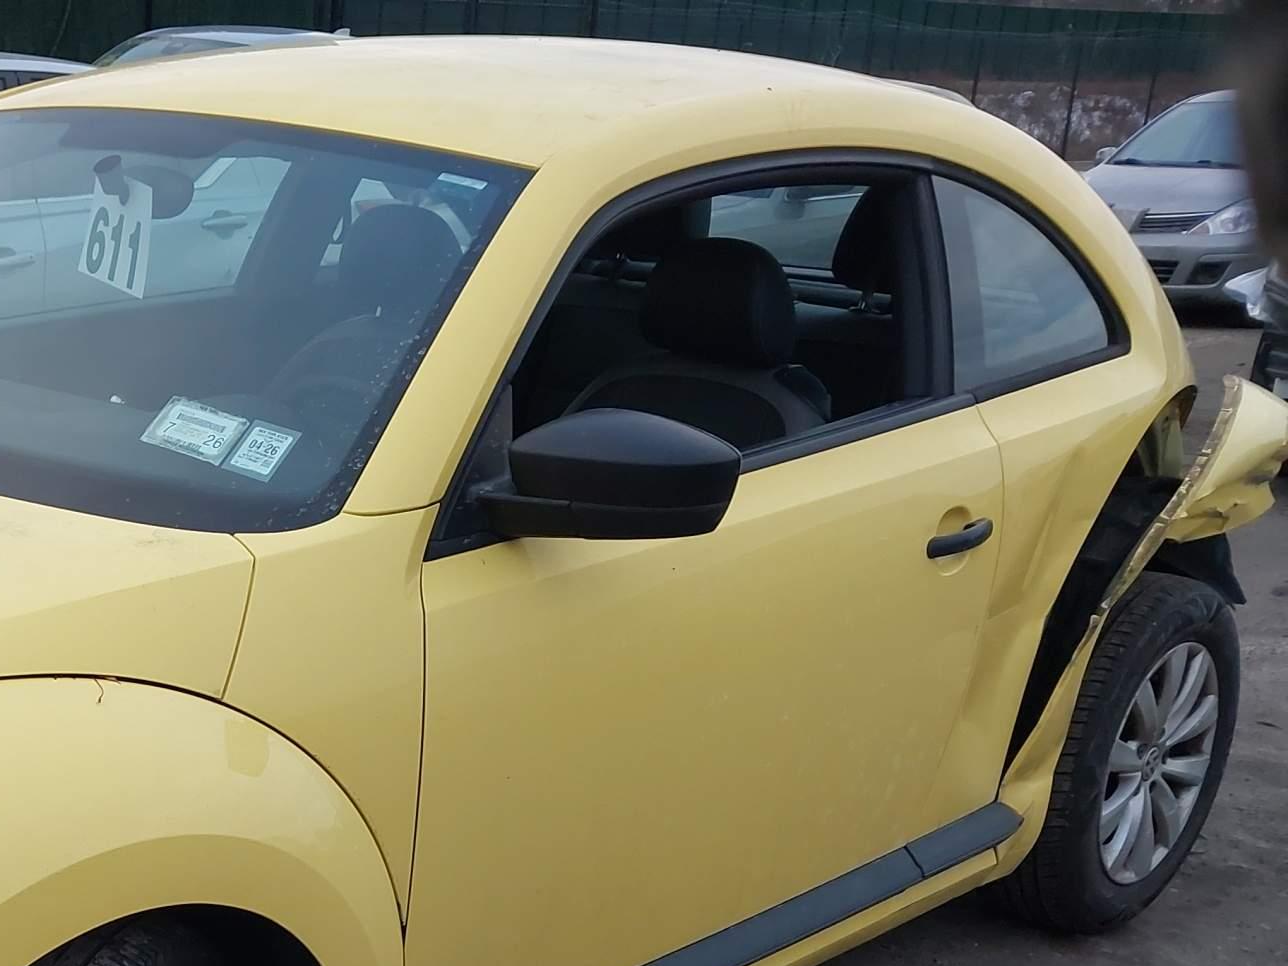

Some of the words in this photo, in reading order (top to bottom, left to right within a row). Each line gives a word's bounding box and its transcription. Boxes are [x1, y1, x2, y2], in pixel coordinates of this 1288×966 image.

[85, 206, 142, 290] 611
[202, 434, 225, 449] 26
[248, 439, 281, 456] 04-26
